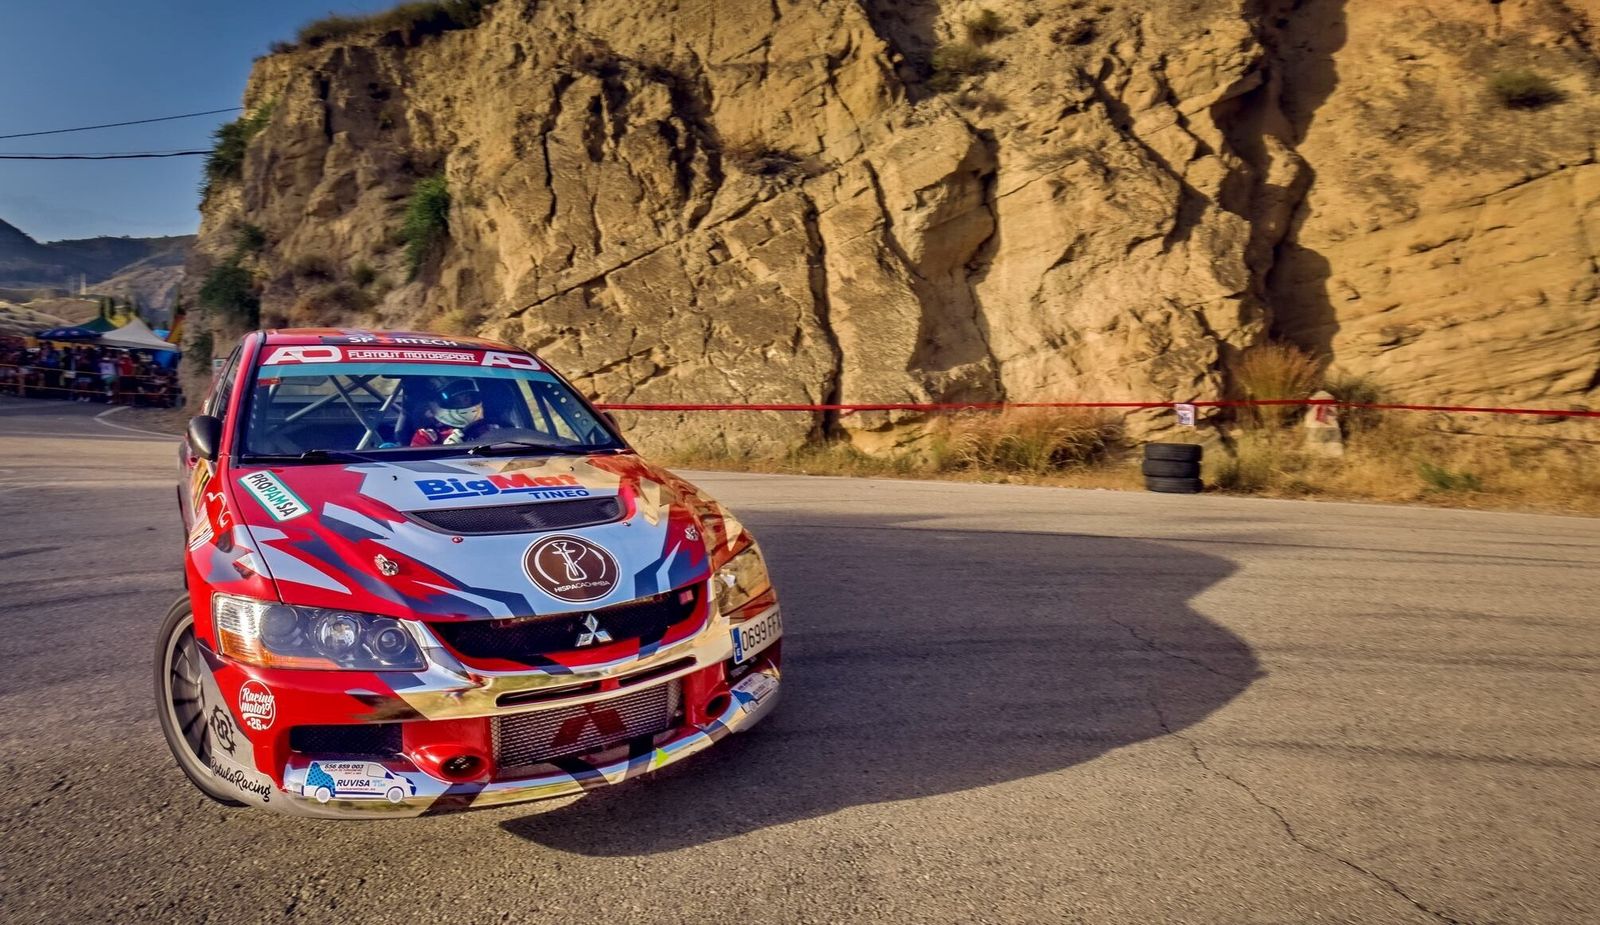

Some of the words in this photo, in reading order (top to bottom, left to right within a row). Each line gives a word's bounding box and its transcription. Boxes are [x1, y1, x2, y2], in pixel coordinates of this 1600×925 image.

[348, 351, 400, 359] FLATOUT
[403, 352, 475, 361] MOTORSPORT
[414, 472, 580, 496] BigMat
[247, 473, 299, 517] PROPAMSA
[527, 489, 590, 499] TINEO
[741, 621, 766, 652] 0699
[242, 687, 275, 711] Racing
[241, 701, 269, 715] motor
[250, 717, 262, 731] 26
[336, 779, 370, 787] RUVISA
